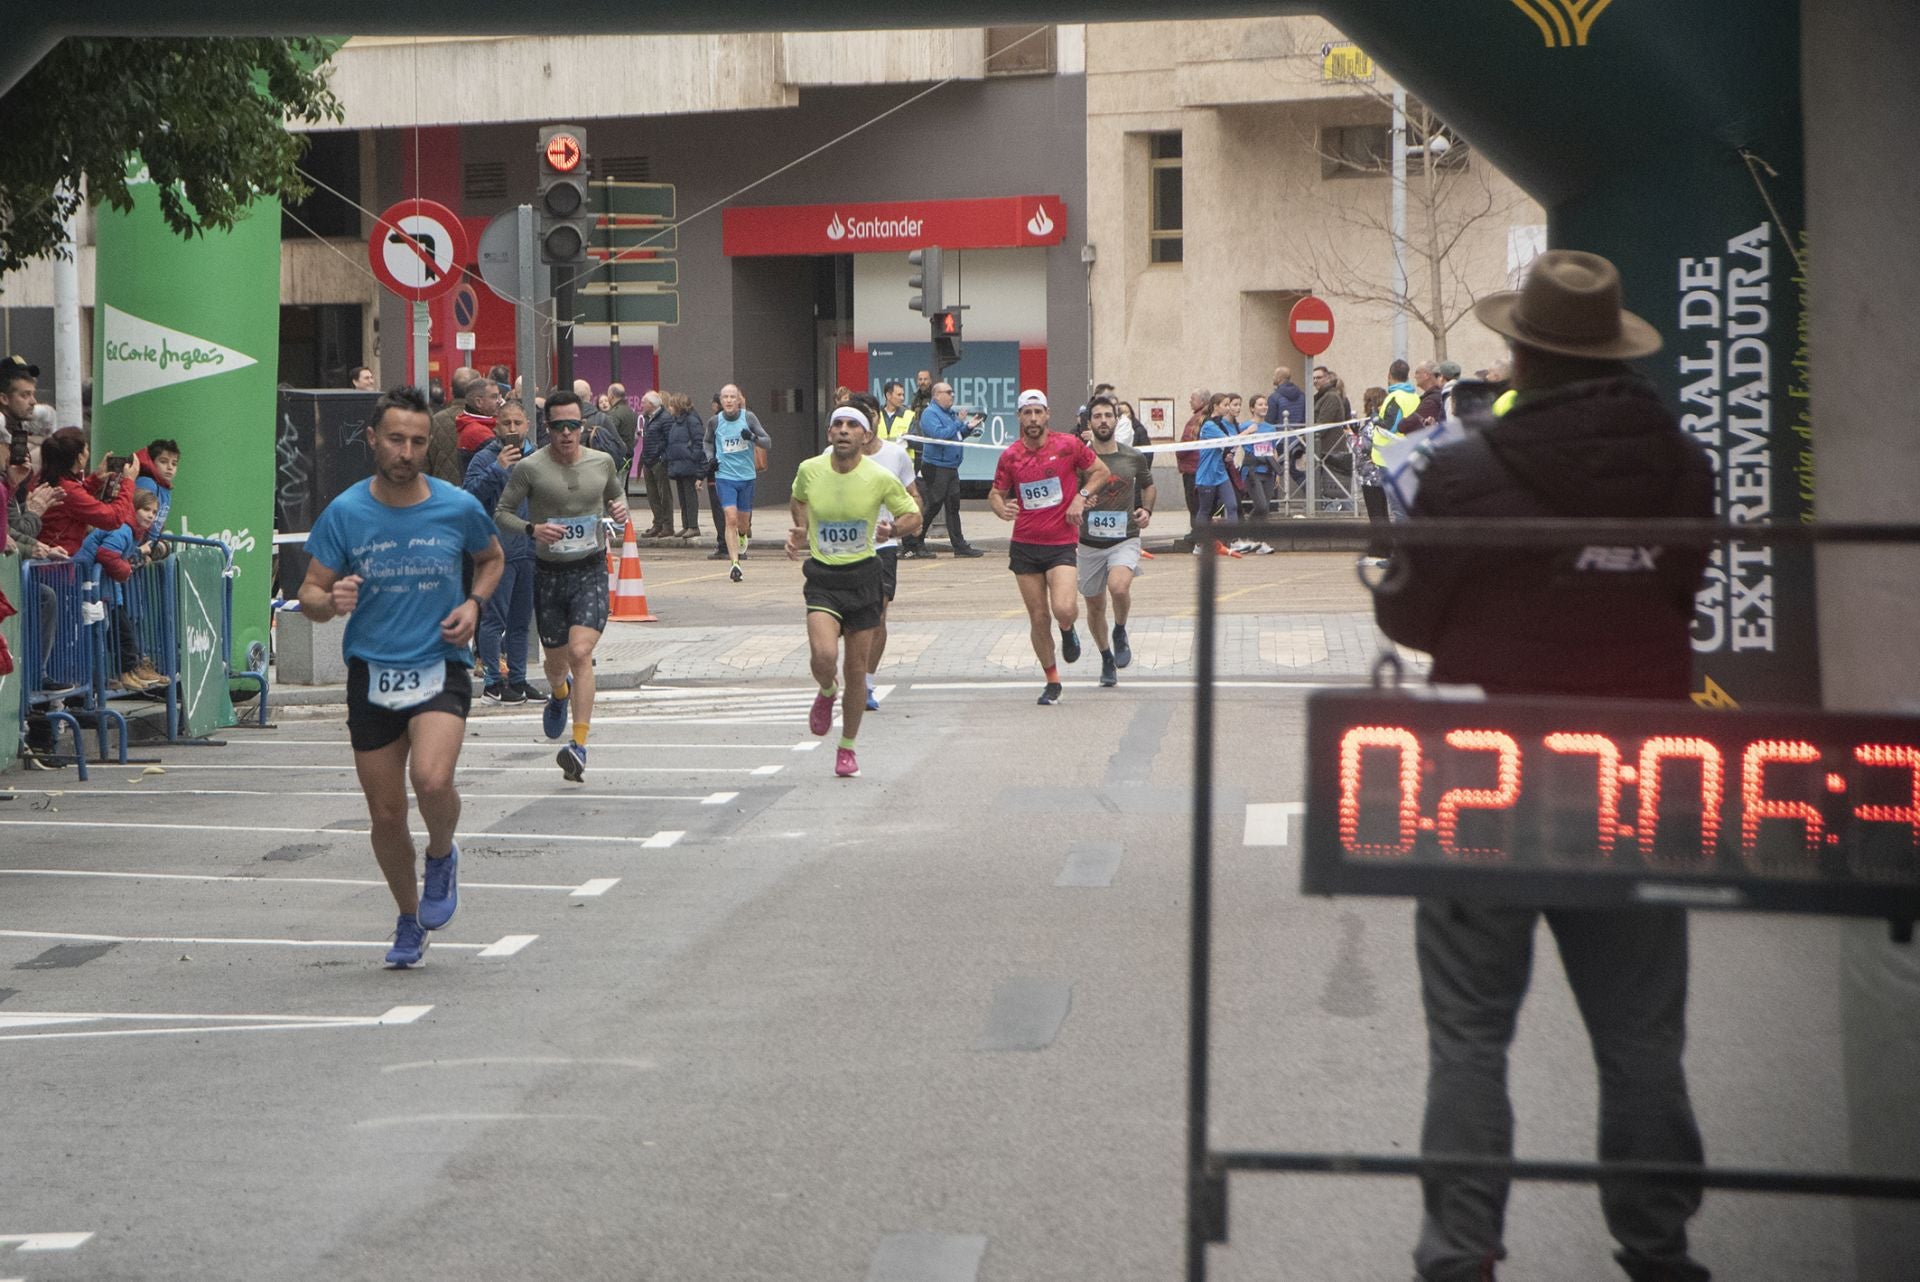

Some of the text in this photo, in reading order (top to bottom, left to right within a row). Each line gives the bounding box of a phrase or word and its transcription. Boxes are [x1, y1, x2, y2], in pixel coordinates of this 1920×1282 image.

[848, 215, 923, 239] Santander
[1680, 256, 1721, 330] DE
[106, 337, 225, 370] El Corte Inglés
[943, 376, 1016, 409] UERTE
[724, 438, 740, 447] 757
[1727, 220, 1774, 653] EXTREMADURA
[1025, 486, 1049, 500] 963
[559, 524, 584, 540] 39
[1093, 516, 1116, 528] 843
[820, 527, 858, 543] 1030
[378, 670, 421, 693] 623
